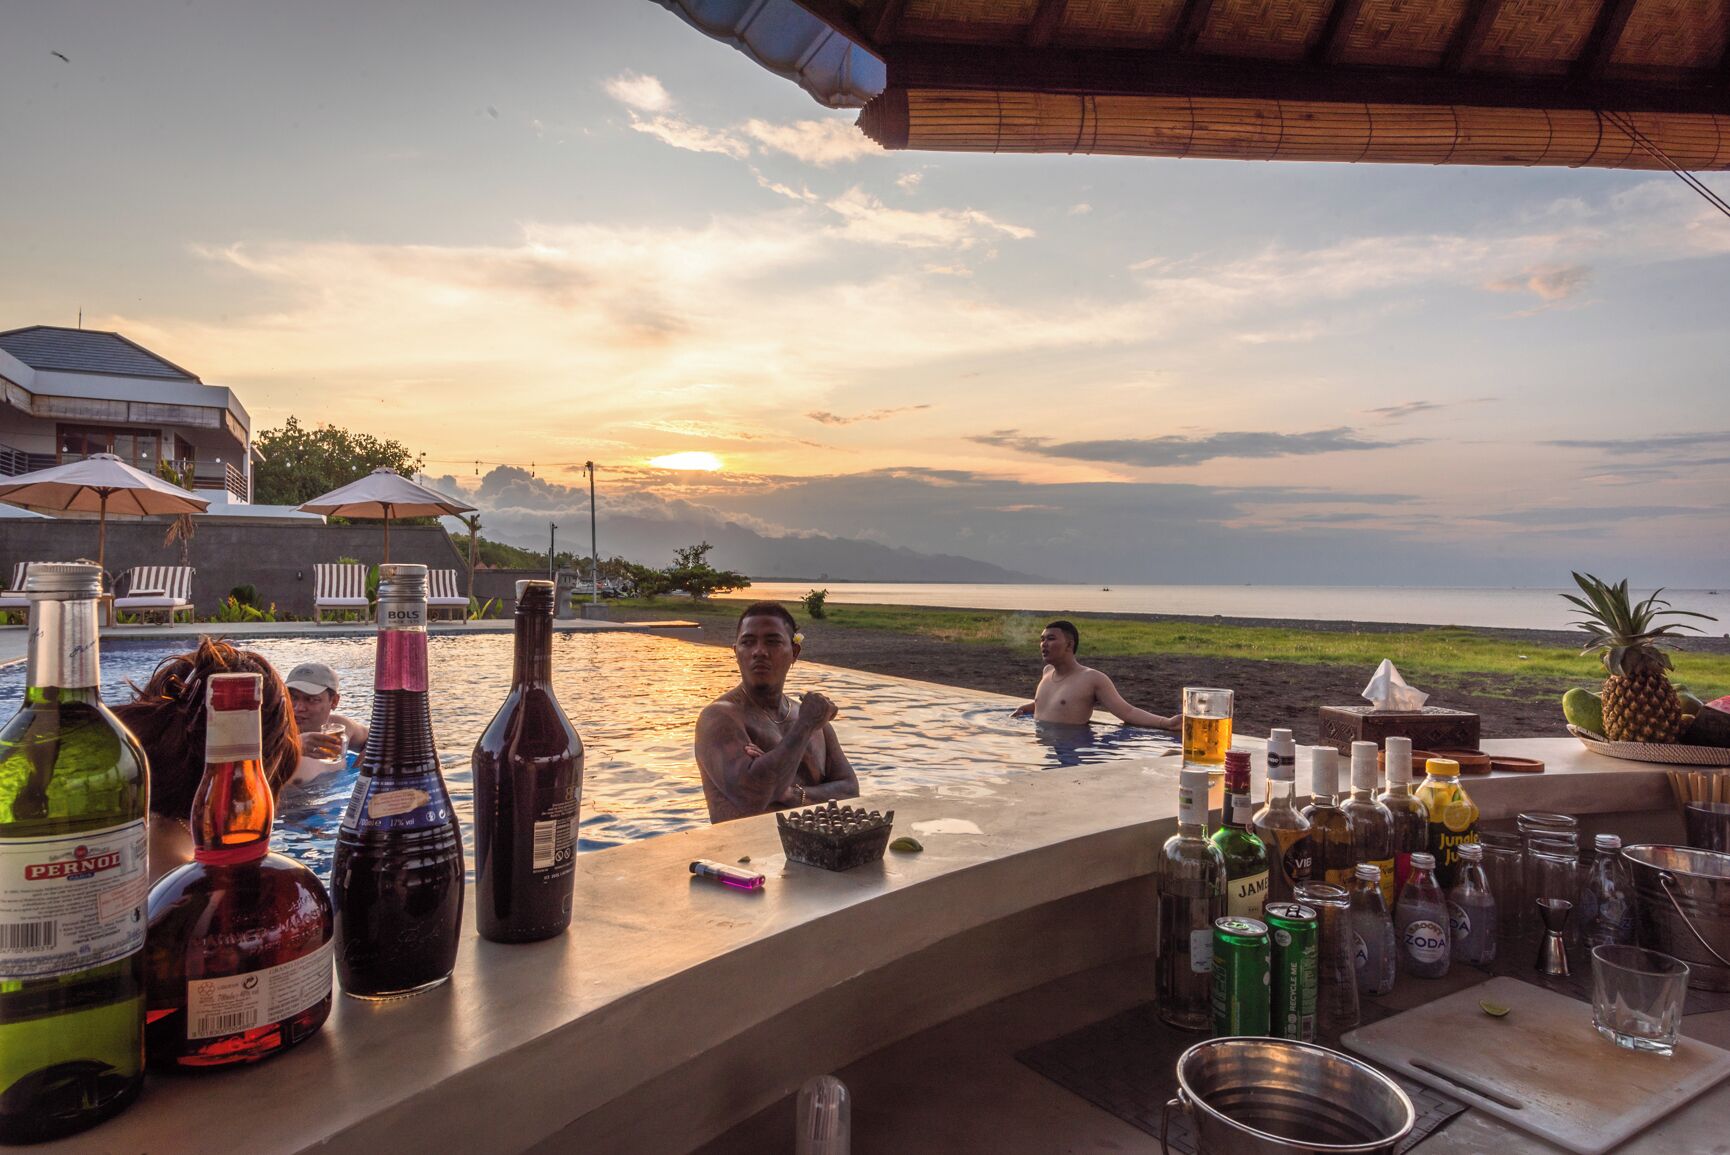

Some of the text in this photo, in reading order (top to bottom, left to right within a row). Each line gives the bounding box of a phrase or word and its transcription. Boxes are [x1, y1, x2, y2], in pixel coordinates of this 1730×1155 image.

[388, 611, 420, 619] BOLS
[1406, 934, 1446, 949] ZODA
[1289, 962, 1298, 1011] RECYCLE ME
